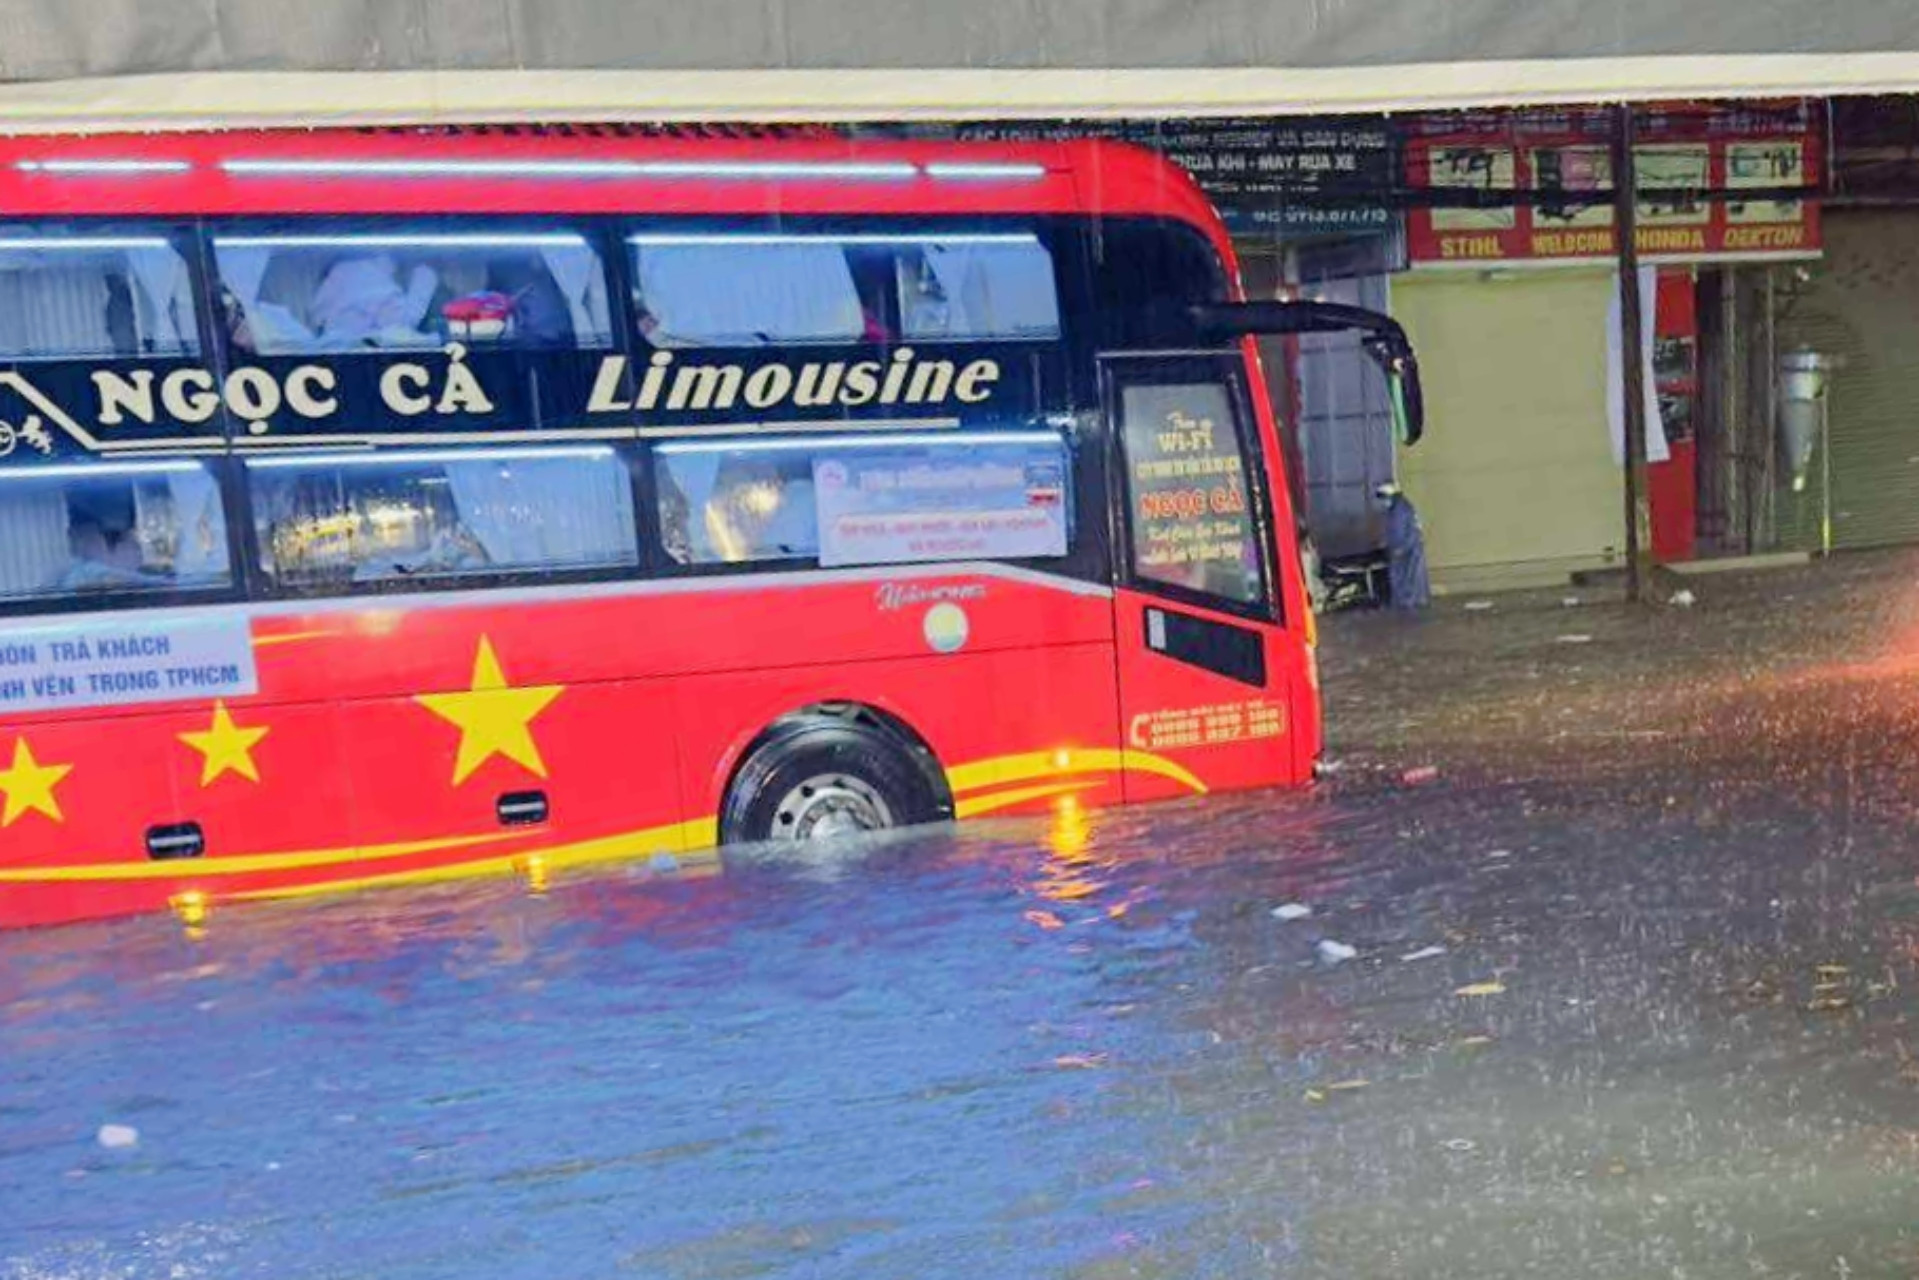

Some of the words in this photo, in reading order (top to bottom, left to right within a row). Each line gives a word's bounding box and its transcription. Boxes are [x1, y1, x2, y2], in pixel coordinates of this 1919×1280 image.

[1440, 235, 1504, 257] STIHL
[1635, 227, 1705, 250] HONDA
[90, 363, 338, 434] NGỌC
[378, 342, 494, 418] CẢ
[586, 346, 999, 413] Limousine
[88, 668, 161, 694] TRONG
[165, 663, 240, 689] TPHCM
